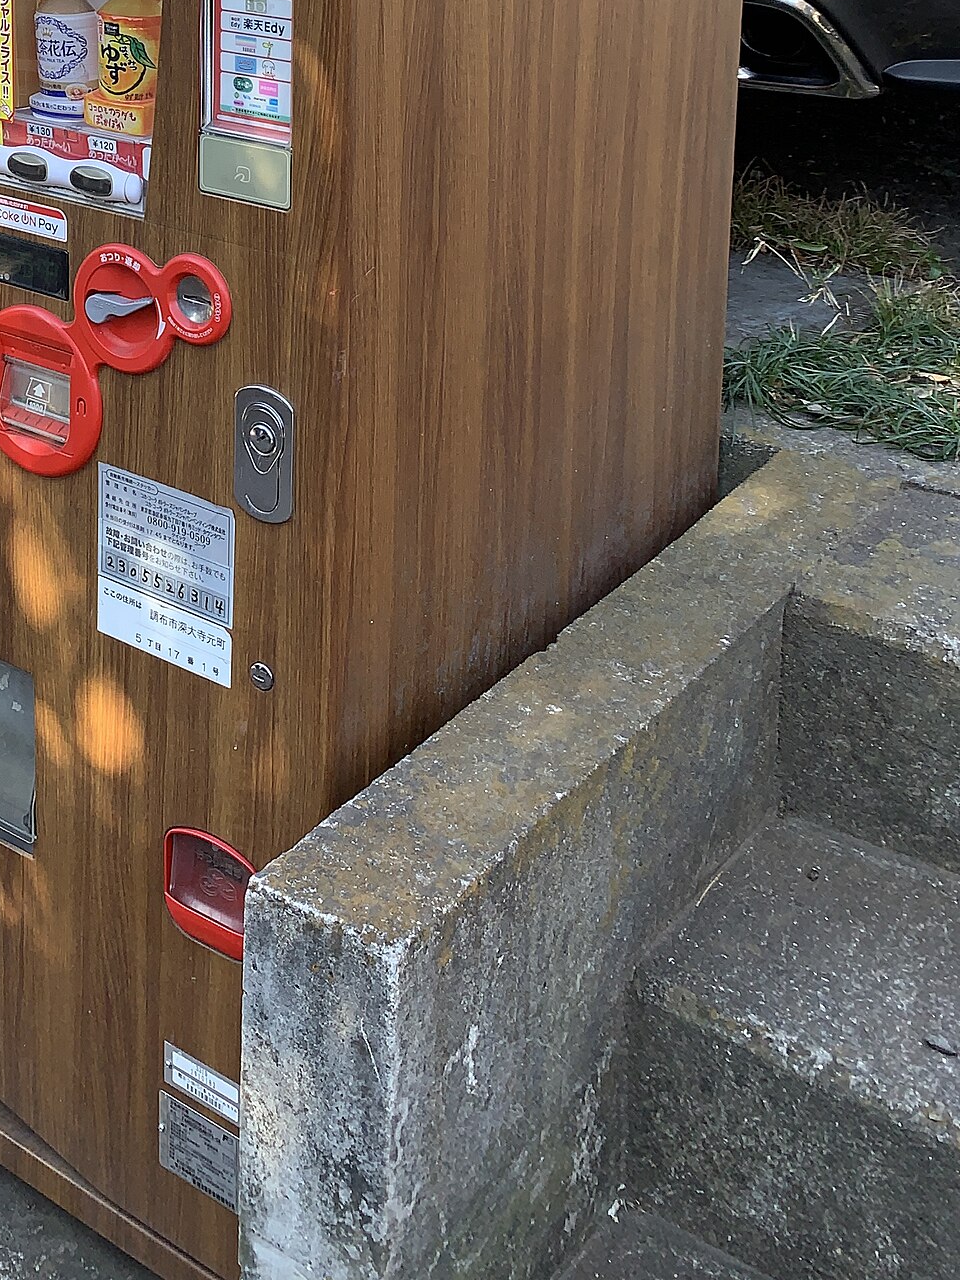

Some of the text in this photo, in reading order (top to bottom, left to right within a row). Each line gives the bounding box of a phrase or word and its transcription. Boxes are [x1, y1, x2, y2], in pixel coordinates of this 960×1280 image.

[243, 18, 285, 36] 楽天Edy
[100, 43, 127, 85] ゆず
[28, 125, 51, 136] ¥130
[92, 140, 114, 151] ¥120
[38, 218, 59, 235] Pay
[147, 515, 211, 546] 0800-919-0509
[107, 556, 225, 615] 2305526314
[103, 587, 142, 610] ここの住所は
[149, 608, 226, 651] 調布市深大寺元町
[135, 632, 142, 644] 5
[168, 647, 180, 660] 17
